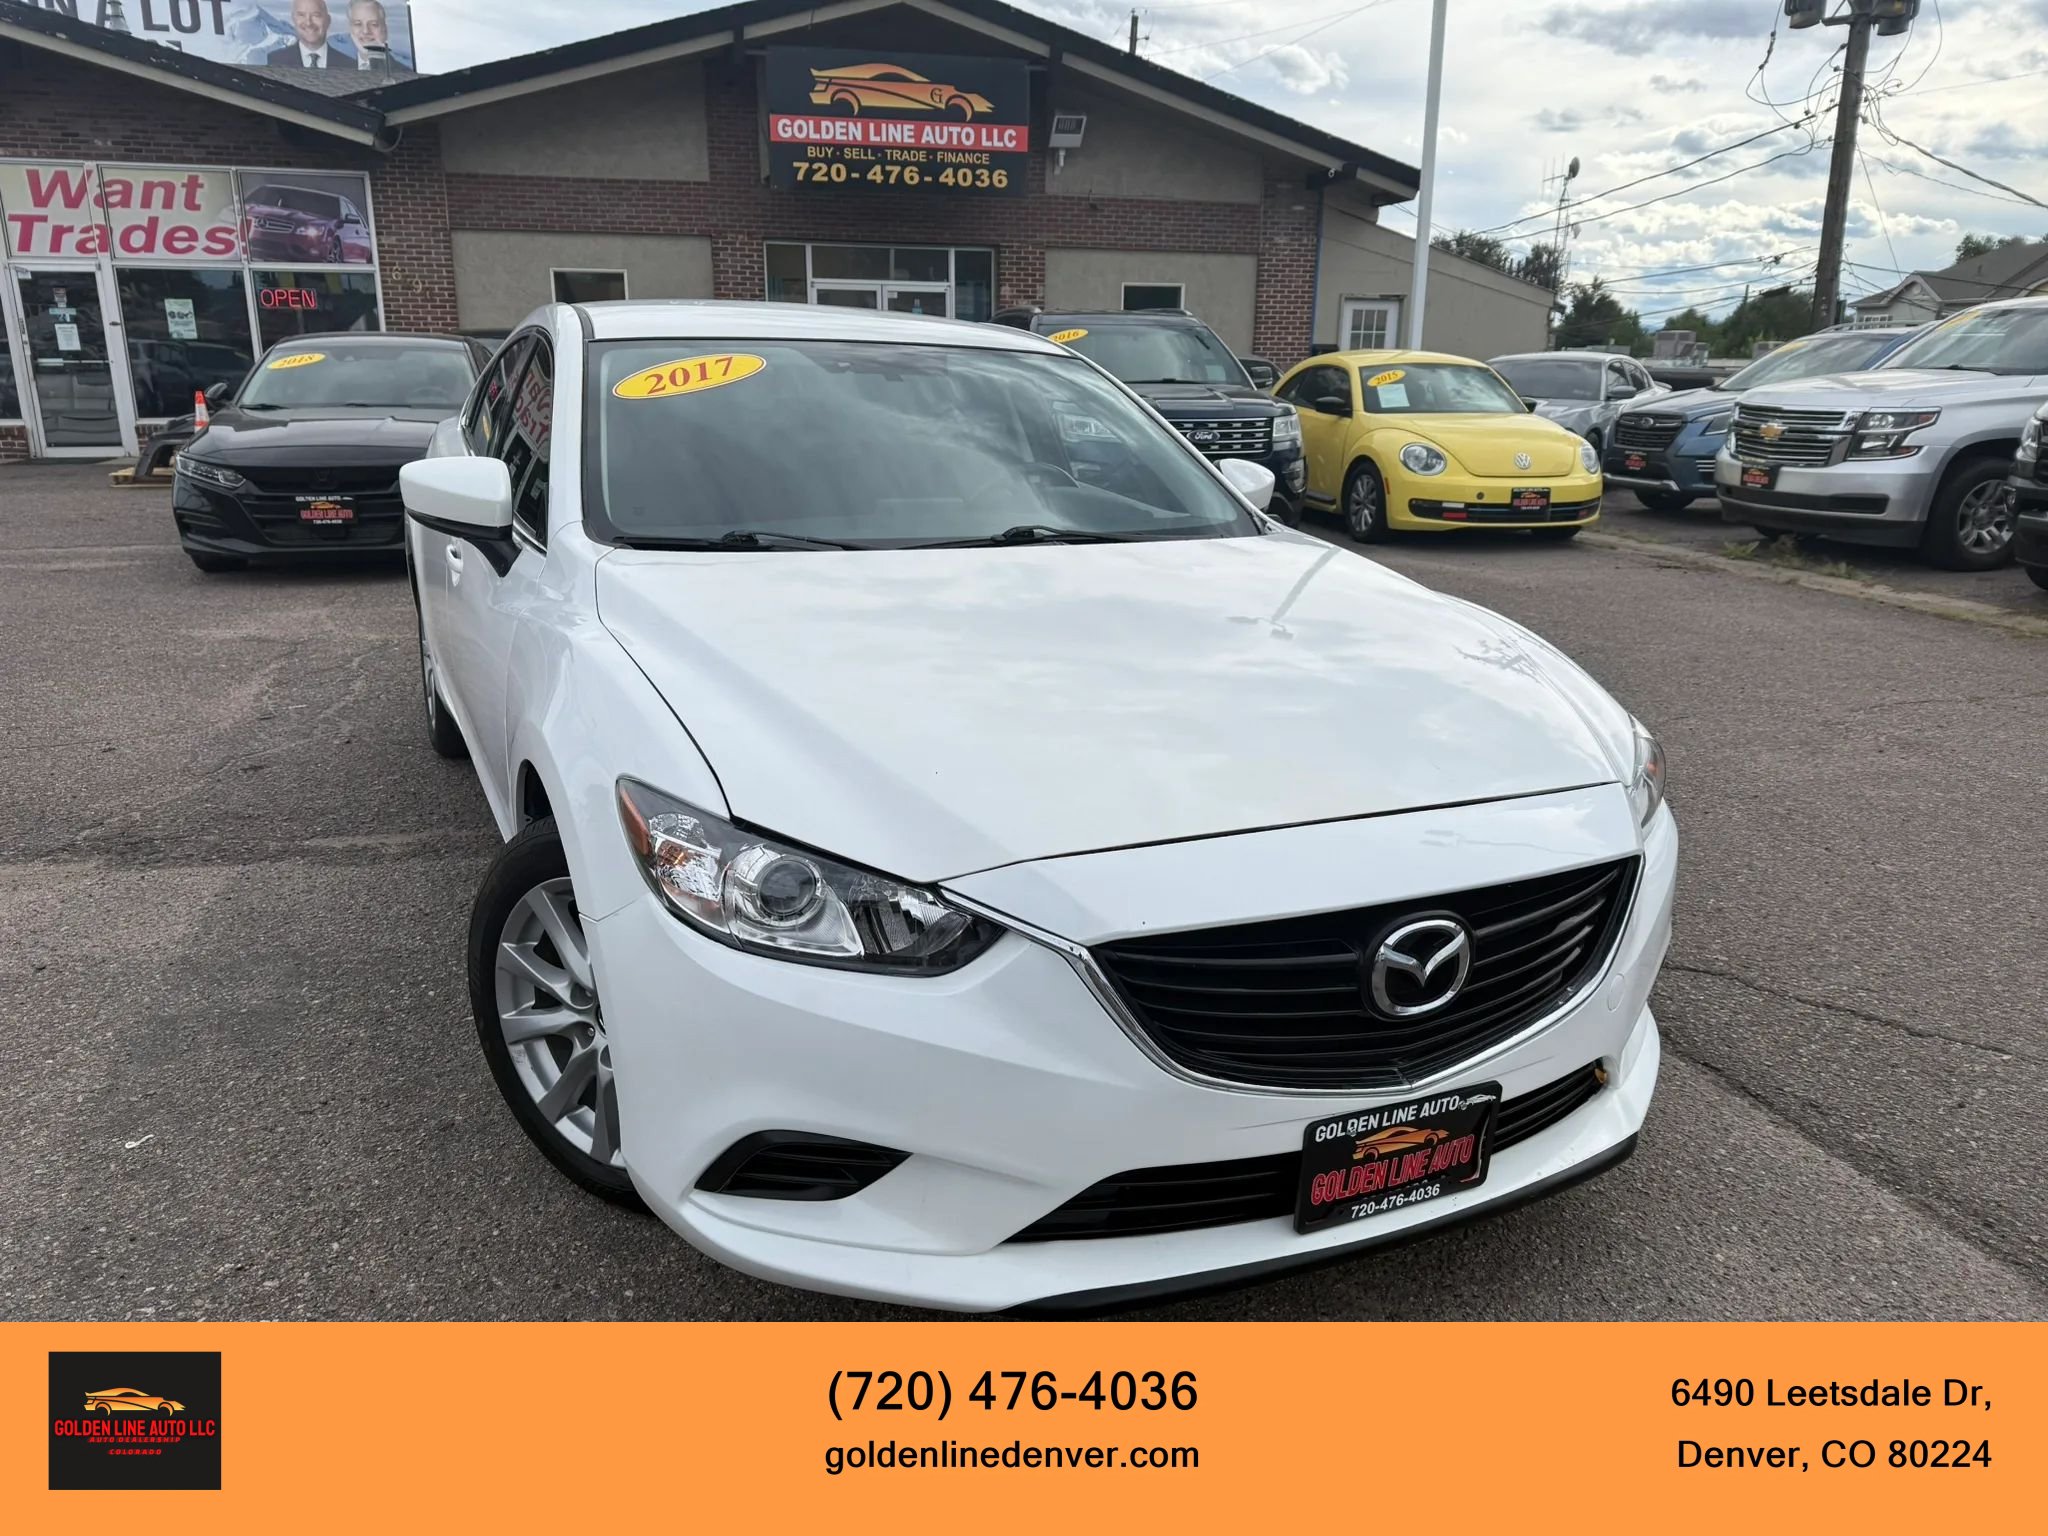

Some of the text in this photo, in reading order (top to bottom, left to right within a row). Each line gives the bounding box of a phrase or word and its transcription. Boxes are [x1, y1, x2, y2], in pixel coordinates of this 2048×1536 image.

[140, 0, 231, 35] LOT
[777, 118, 1017, 148] GOLDEN LINE AUTO LLC
[807, 146, 990, 165] BUY SELL TRADE FINANCE
[25, 168, 205, 210] Want
[260, 288, 317, 309] OPEN
[644, 356, 733, 395] 2017
[1315, 1095, 1460, 1143] GOLDEN LINE AUTO
[1311, 1134, 1475, 1205] GOLDEN LINE AUTO
[1352, 1184, 1440, 1218] 720-476-4036
